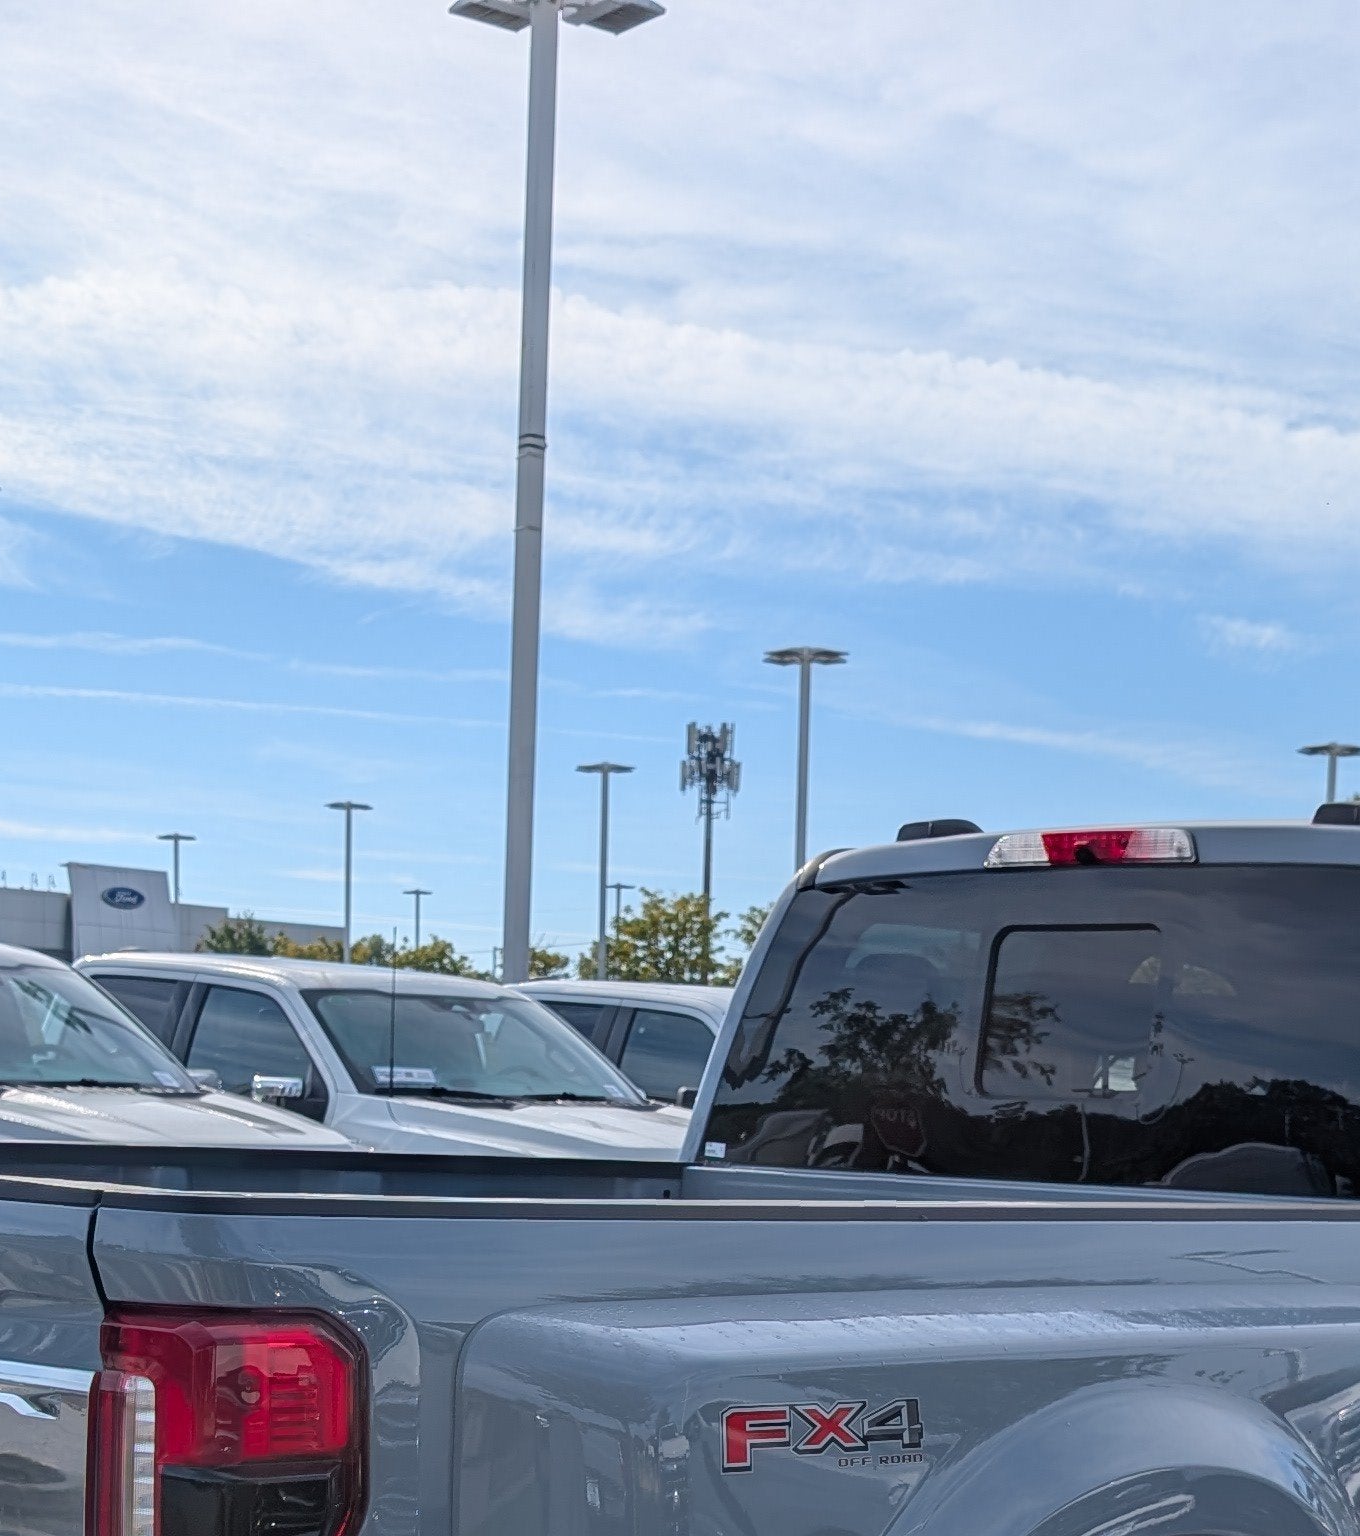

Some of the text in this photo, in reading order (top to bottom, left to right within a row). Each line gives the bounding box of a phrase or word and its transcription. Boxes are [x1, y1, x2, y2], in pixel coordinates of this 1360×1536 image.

[720, 1397, 924, 1475] FX4
[837, 1453, 924, 1467] OFF ROAD
